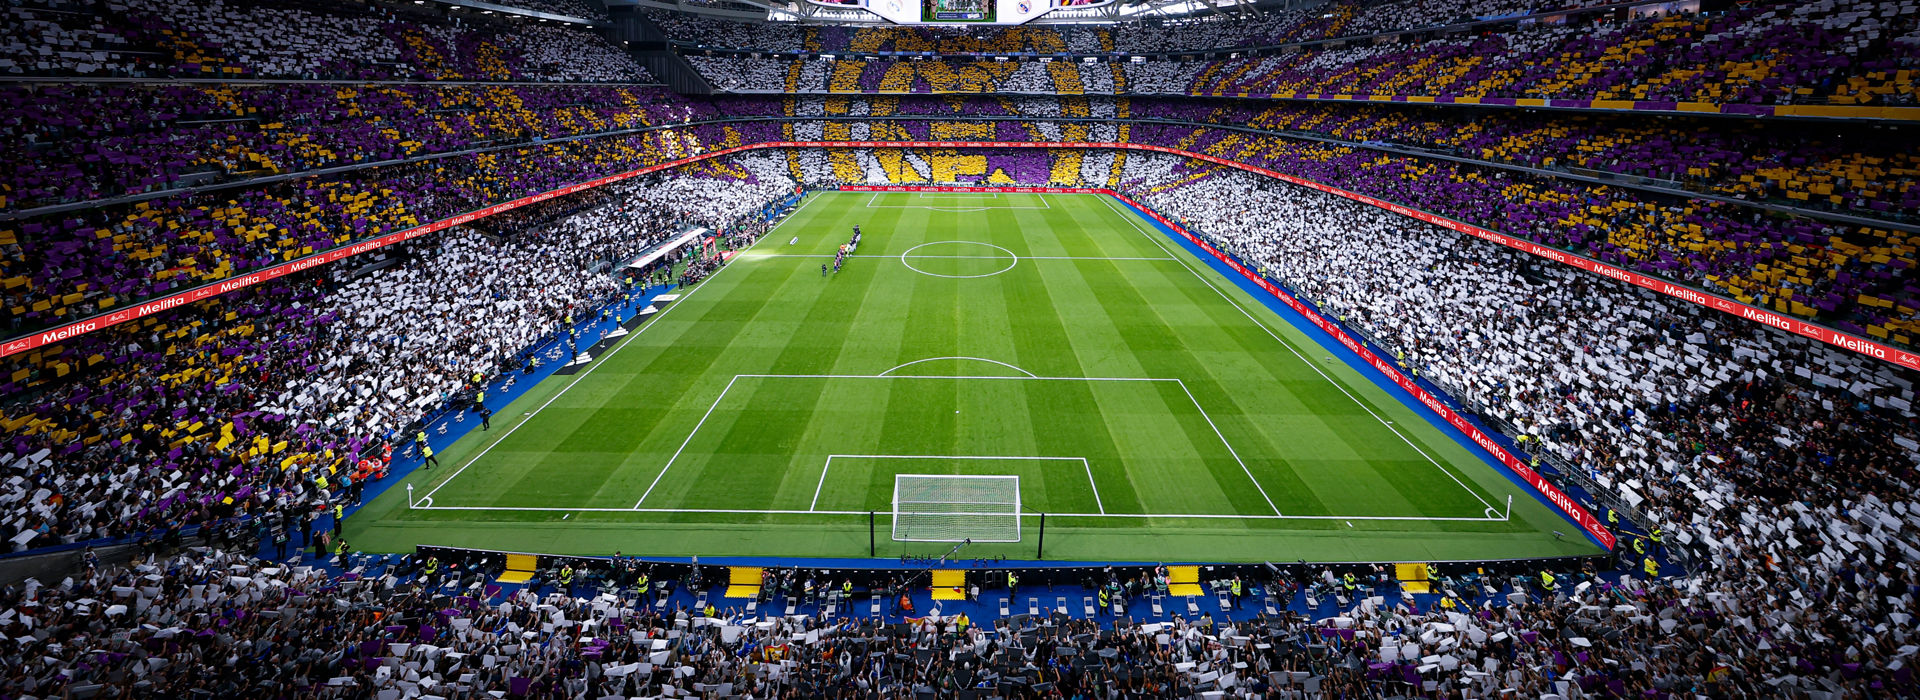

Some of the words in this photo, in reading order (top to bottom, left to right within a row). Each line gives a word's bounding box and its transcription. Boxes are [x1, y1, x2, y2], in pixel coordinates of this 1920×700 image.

[605, 175, 623, 183] Melitta
[571, 184, 590, 192] Melitta
[532, 193, 553, 202] Melitta
[493, 203, 514, 213] Melitta
[1391, 204, 1412, 216] Melitta
[452, 214, 475, 226] Melitta
[1432, 217, 1456, 230] Melitta
[405, 227, 430, 239] Melitta
[1479, 231, 1506, 244] Melitta
[352, 242, 380, 254] Melitta
[1533, 246, 1564, 262] Melitta
[291, 258, 324, 272] Melitta
[1594, 263, 1630, 281] Melitta
[221, 276, 259, 292] Melitta
[1664, 285, 1705, 304] Melitta
[139, 298, 184, 316] Melitta
[1744, 308, 1789, 329] Melitta
[42, 323, 95, 344] Melitta
[1338, 331, 1358, 352] Melitta
[1833, 334, 1884, 358] Melitta
[1376, 359, 1399, 382] Melitta
[1420, 391, 1446, 418] Melitta
[1472, 430, 1505, 461] Melitta
[1538, 480, 1580, 521] Melitta
